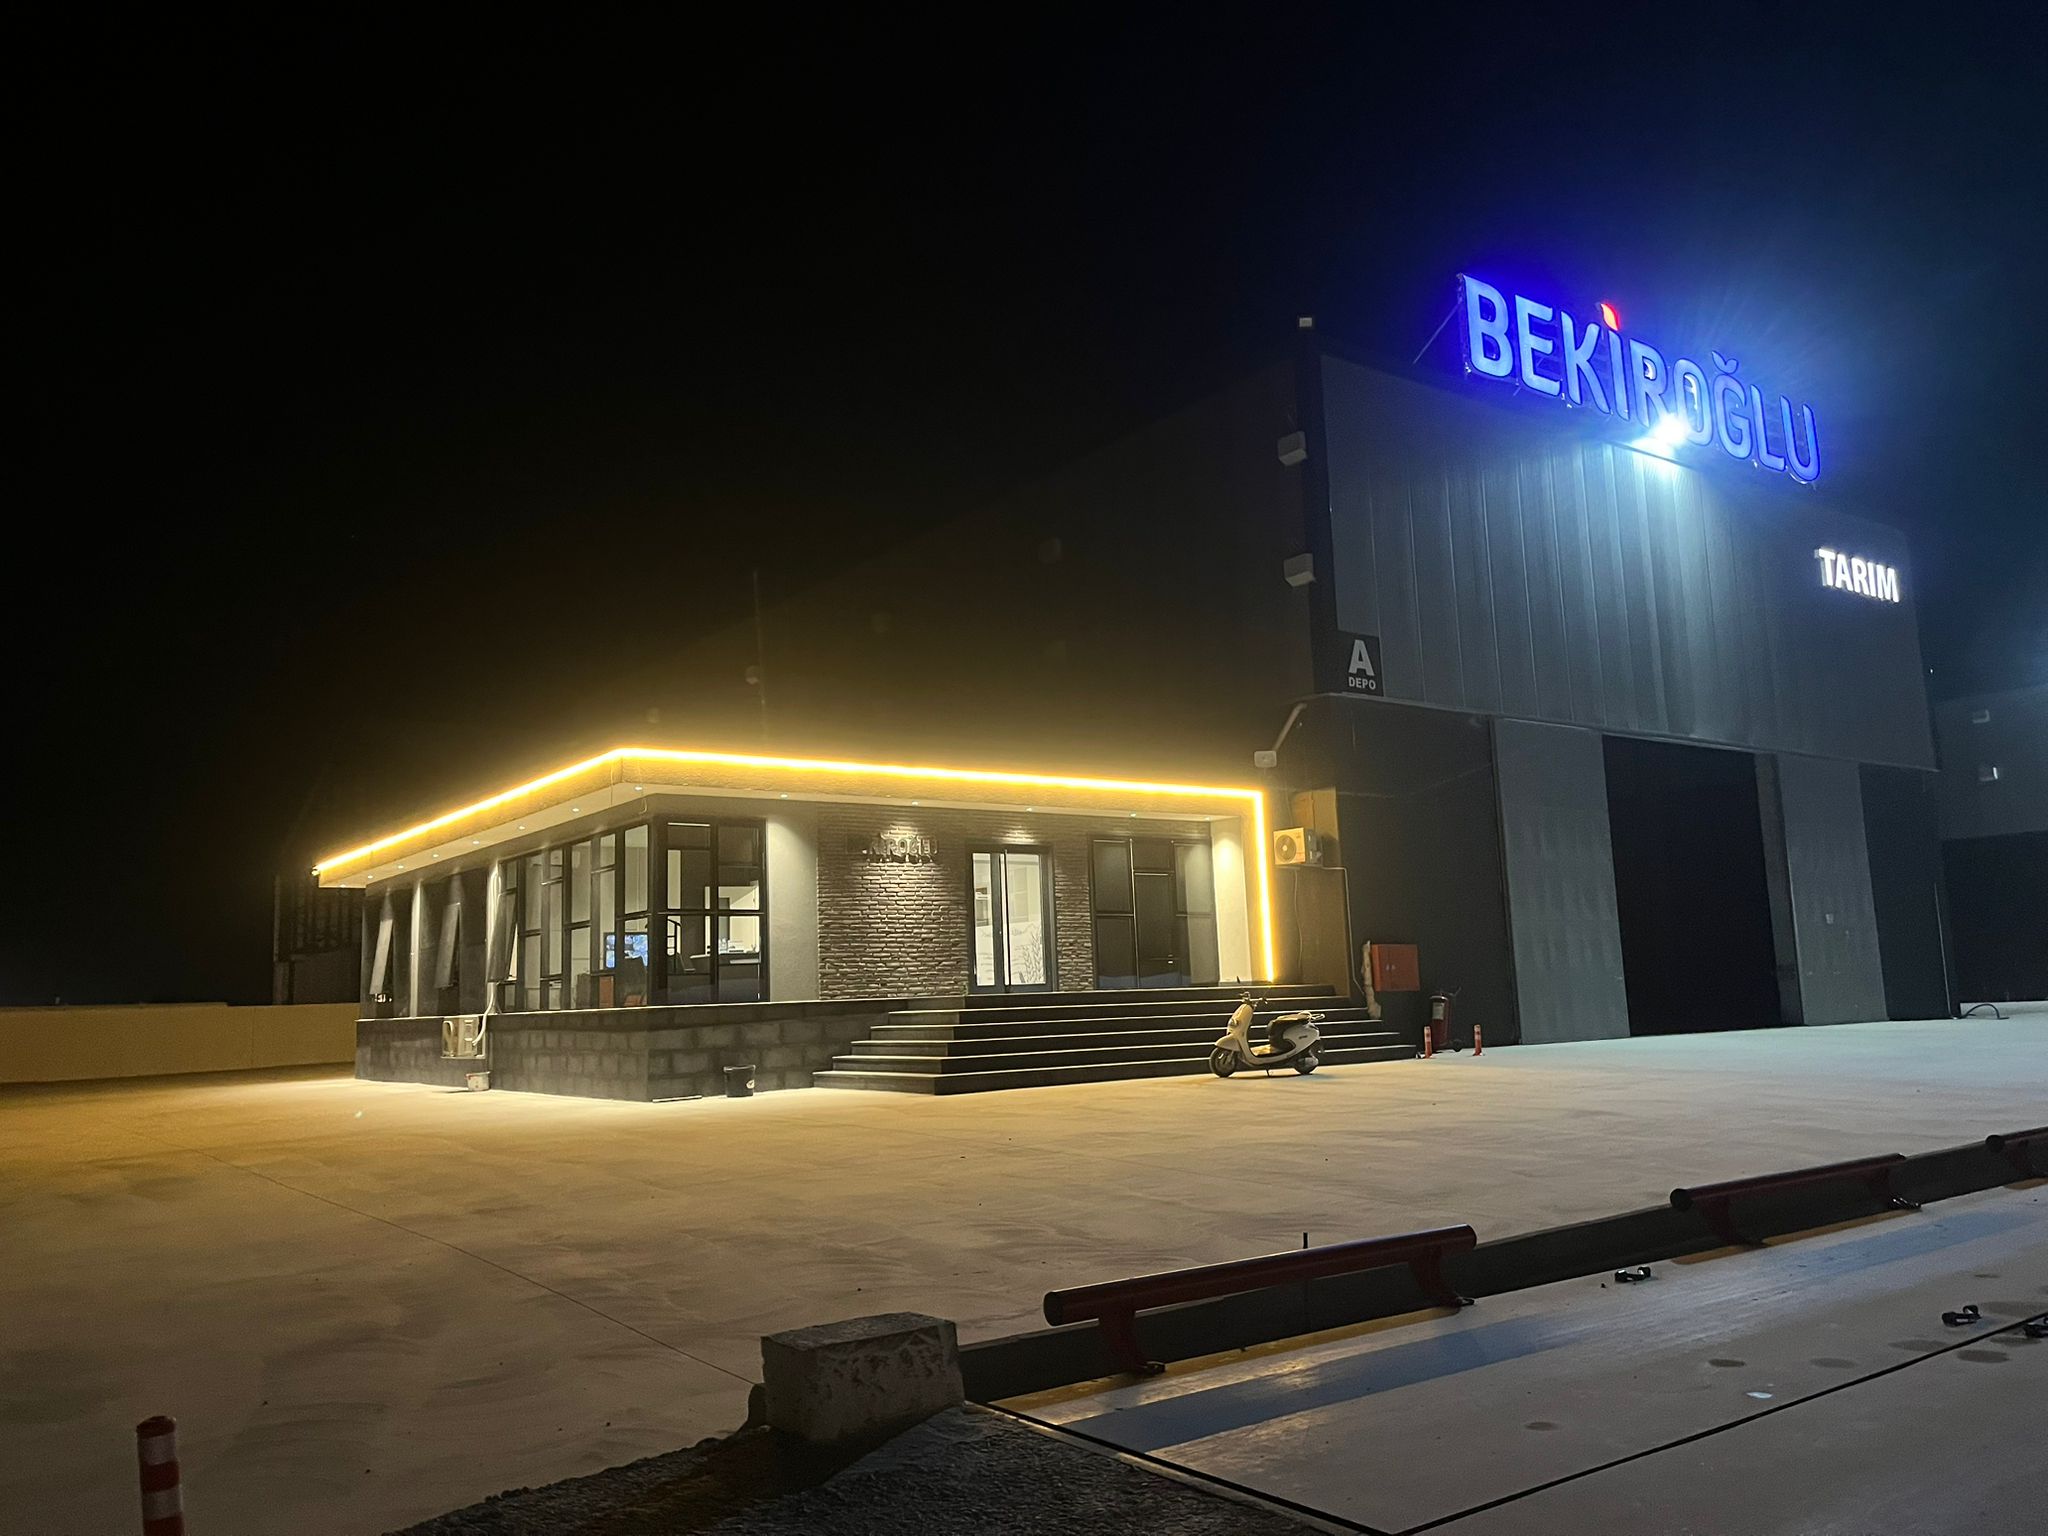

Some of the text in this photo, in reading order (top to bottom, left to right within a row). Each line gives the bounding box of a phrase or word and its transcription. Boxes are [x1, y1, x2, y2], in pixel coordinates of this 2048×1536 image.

[1463, 273, 1820, 483] BEKİROĞLU
[1817, 548, 1900, 603] TARIM
[1348, 639, 1375, 676] A
[1348, 676, 1376, 690] DEPO
